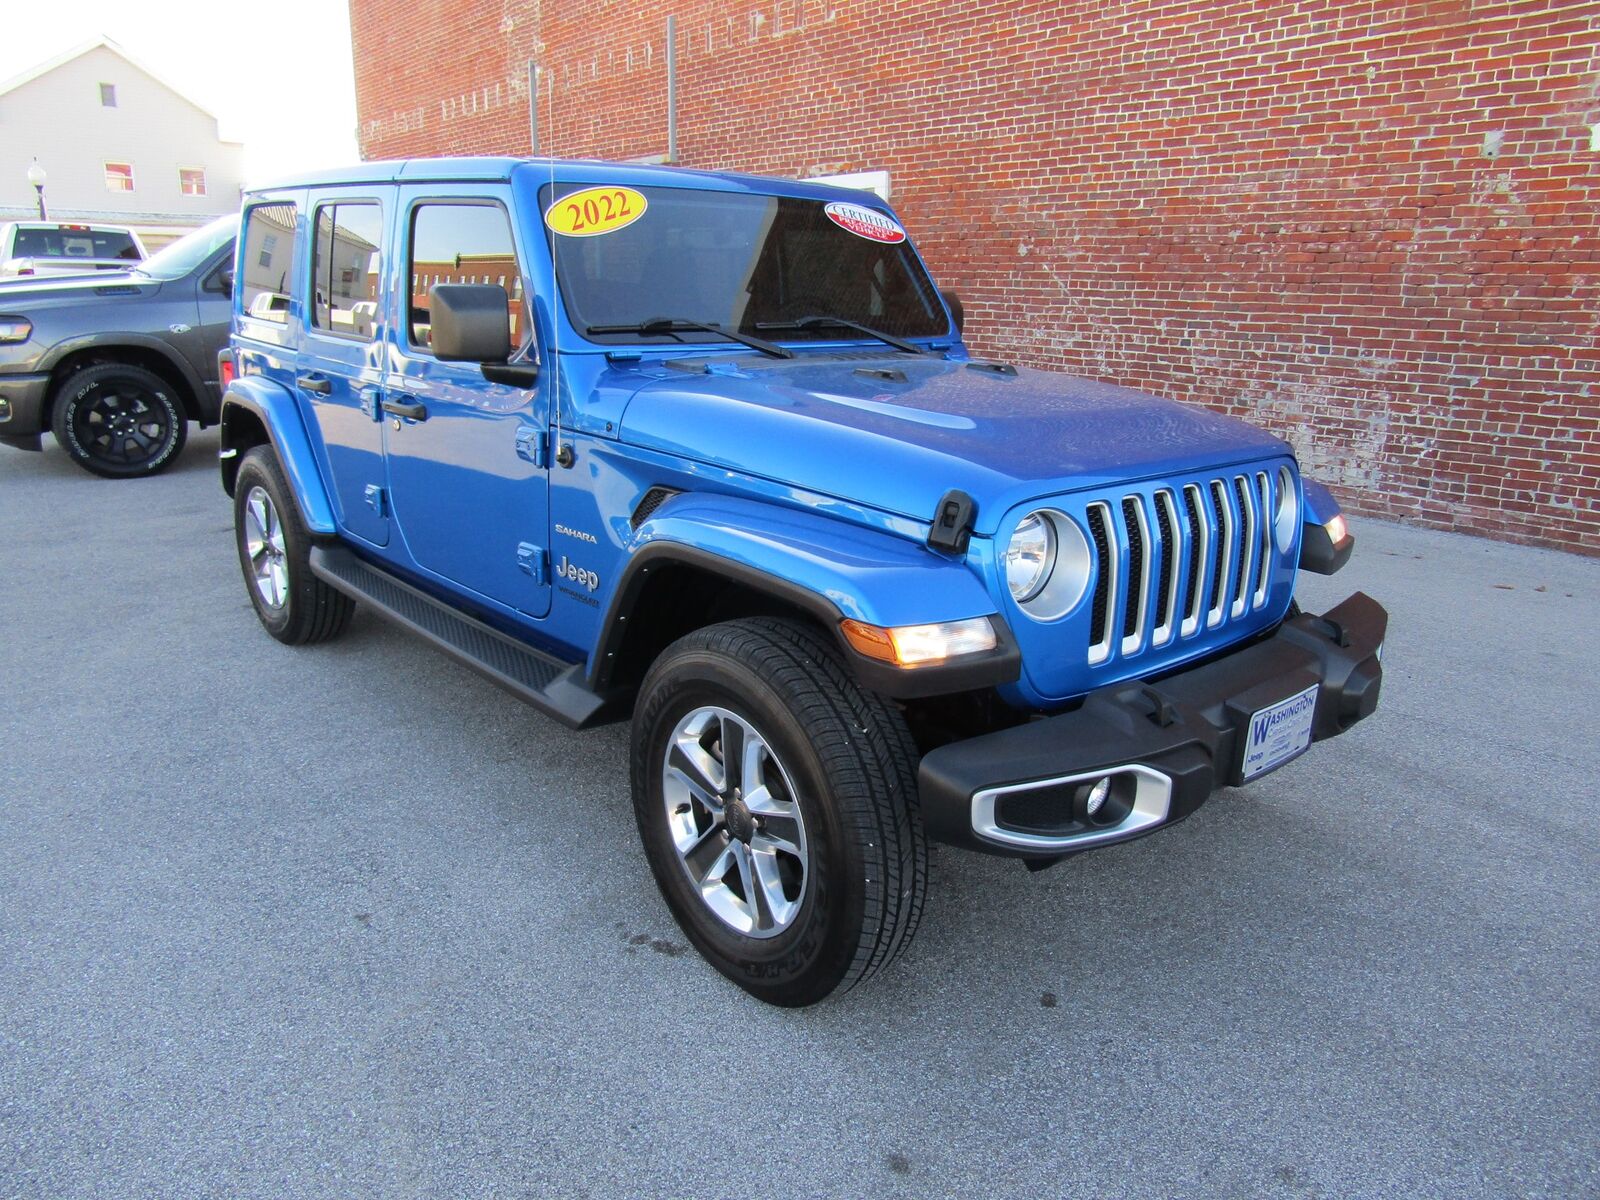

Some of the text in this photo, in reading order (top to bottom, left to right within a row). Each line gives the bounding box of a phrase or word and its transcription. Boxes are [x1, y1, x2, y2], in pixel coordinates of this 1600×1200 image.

[566, 191, 631, 231] 2022
[833, 205, 895, 230] CERTIFIED
[555, 524, 598, 544] SAHARA
[556, 556, 600, 592] Jeep
[1253, 693, 1314, 746] WASHINGTON
